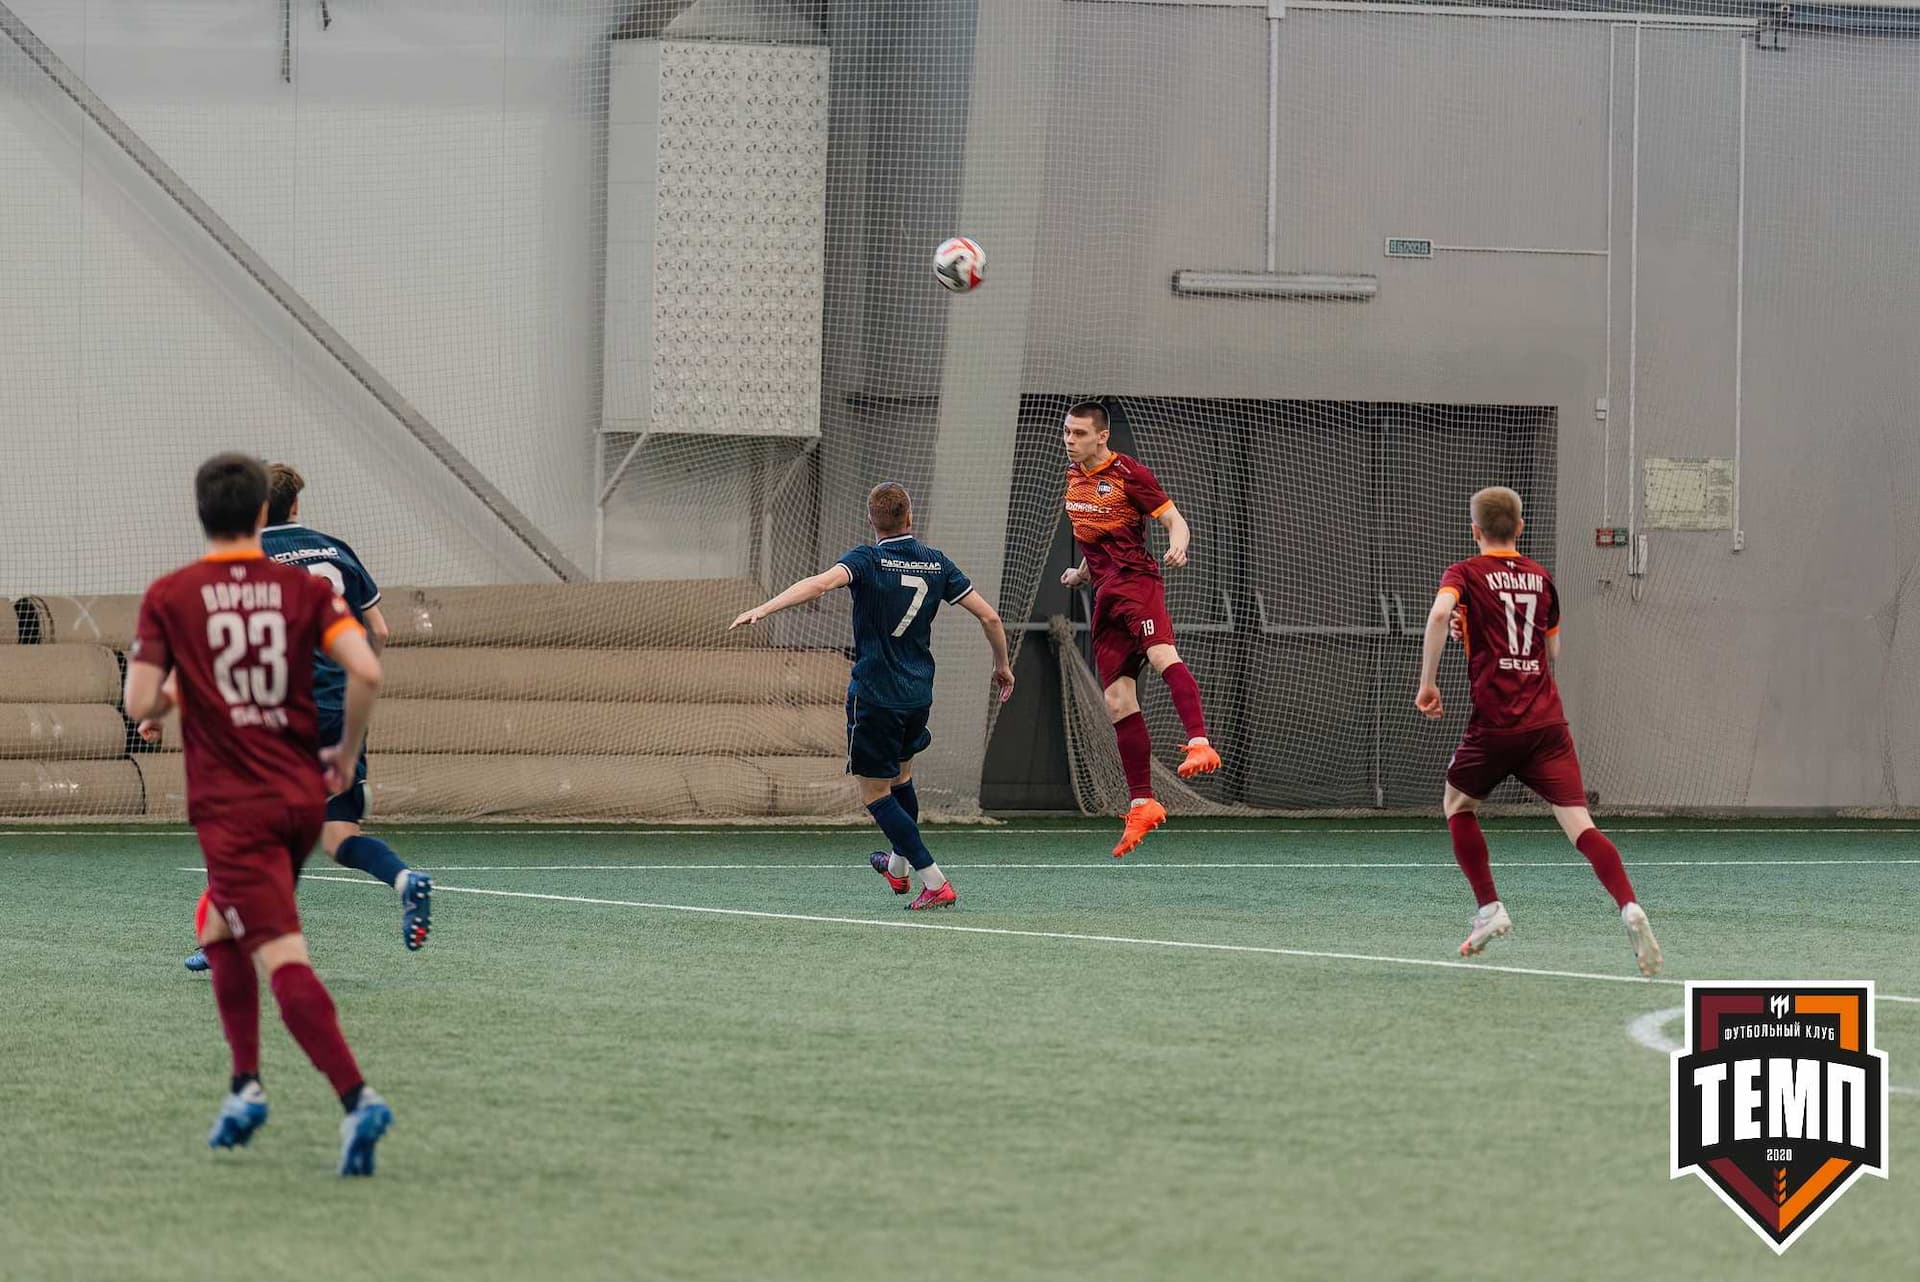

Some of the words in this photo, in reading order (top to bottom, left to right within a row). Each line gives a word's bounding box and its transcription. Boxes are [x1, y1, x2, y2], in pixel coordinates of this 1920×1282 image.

[881, 559, 941, 571] РАСПАДСКАЯ
[1485, 571, 1543, 592] КУЗЬКИН
[201, 582, 282, 612] ВОРОНА
[891, 574, 928, 637] 7
[1141, 619, 1155, 637] 19
[1499, 591, 1537, 656] 17
[207, 611, 288, 706] 23
[1499, 658, 1539, 671] SEUS
